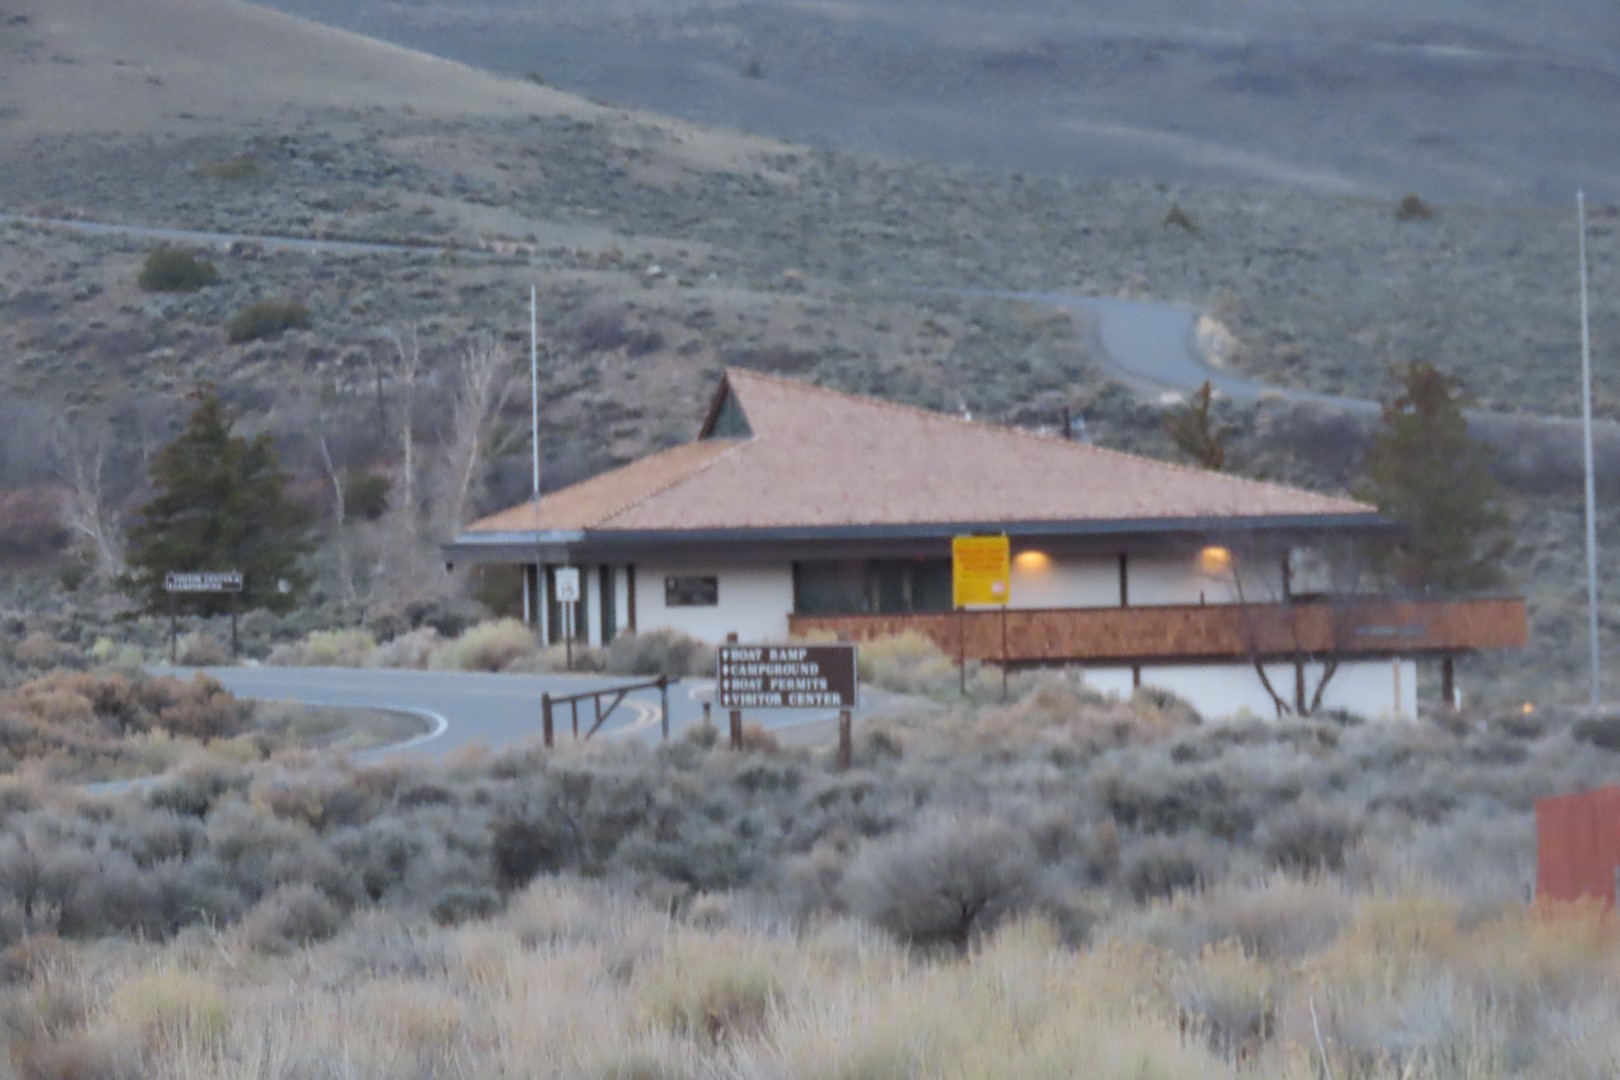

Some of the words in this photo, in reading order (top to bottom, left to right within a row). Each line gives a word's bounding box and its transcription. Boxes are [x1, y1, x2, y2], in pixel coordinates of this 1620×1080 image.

[769, 648, 807, 660] RAMP
[731, 662, 819, 676] CAMPGROUND
[770, 676, 827, 690] PERMITS
[732, 692, 781, 705] VISITOR
[789, 692, 841, 705] CENTER
